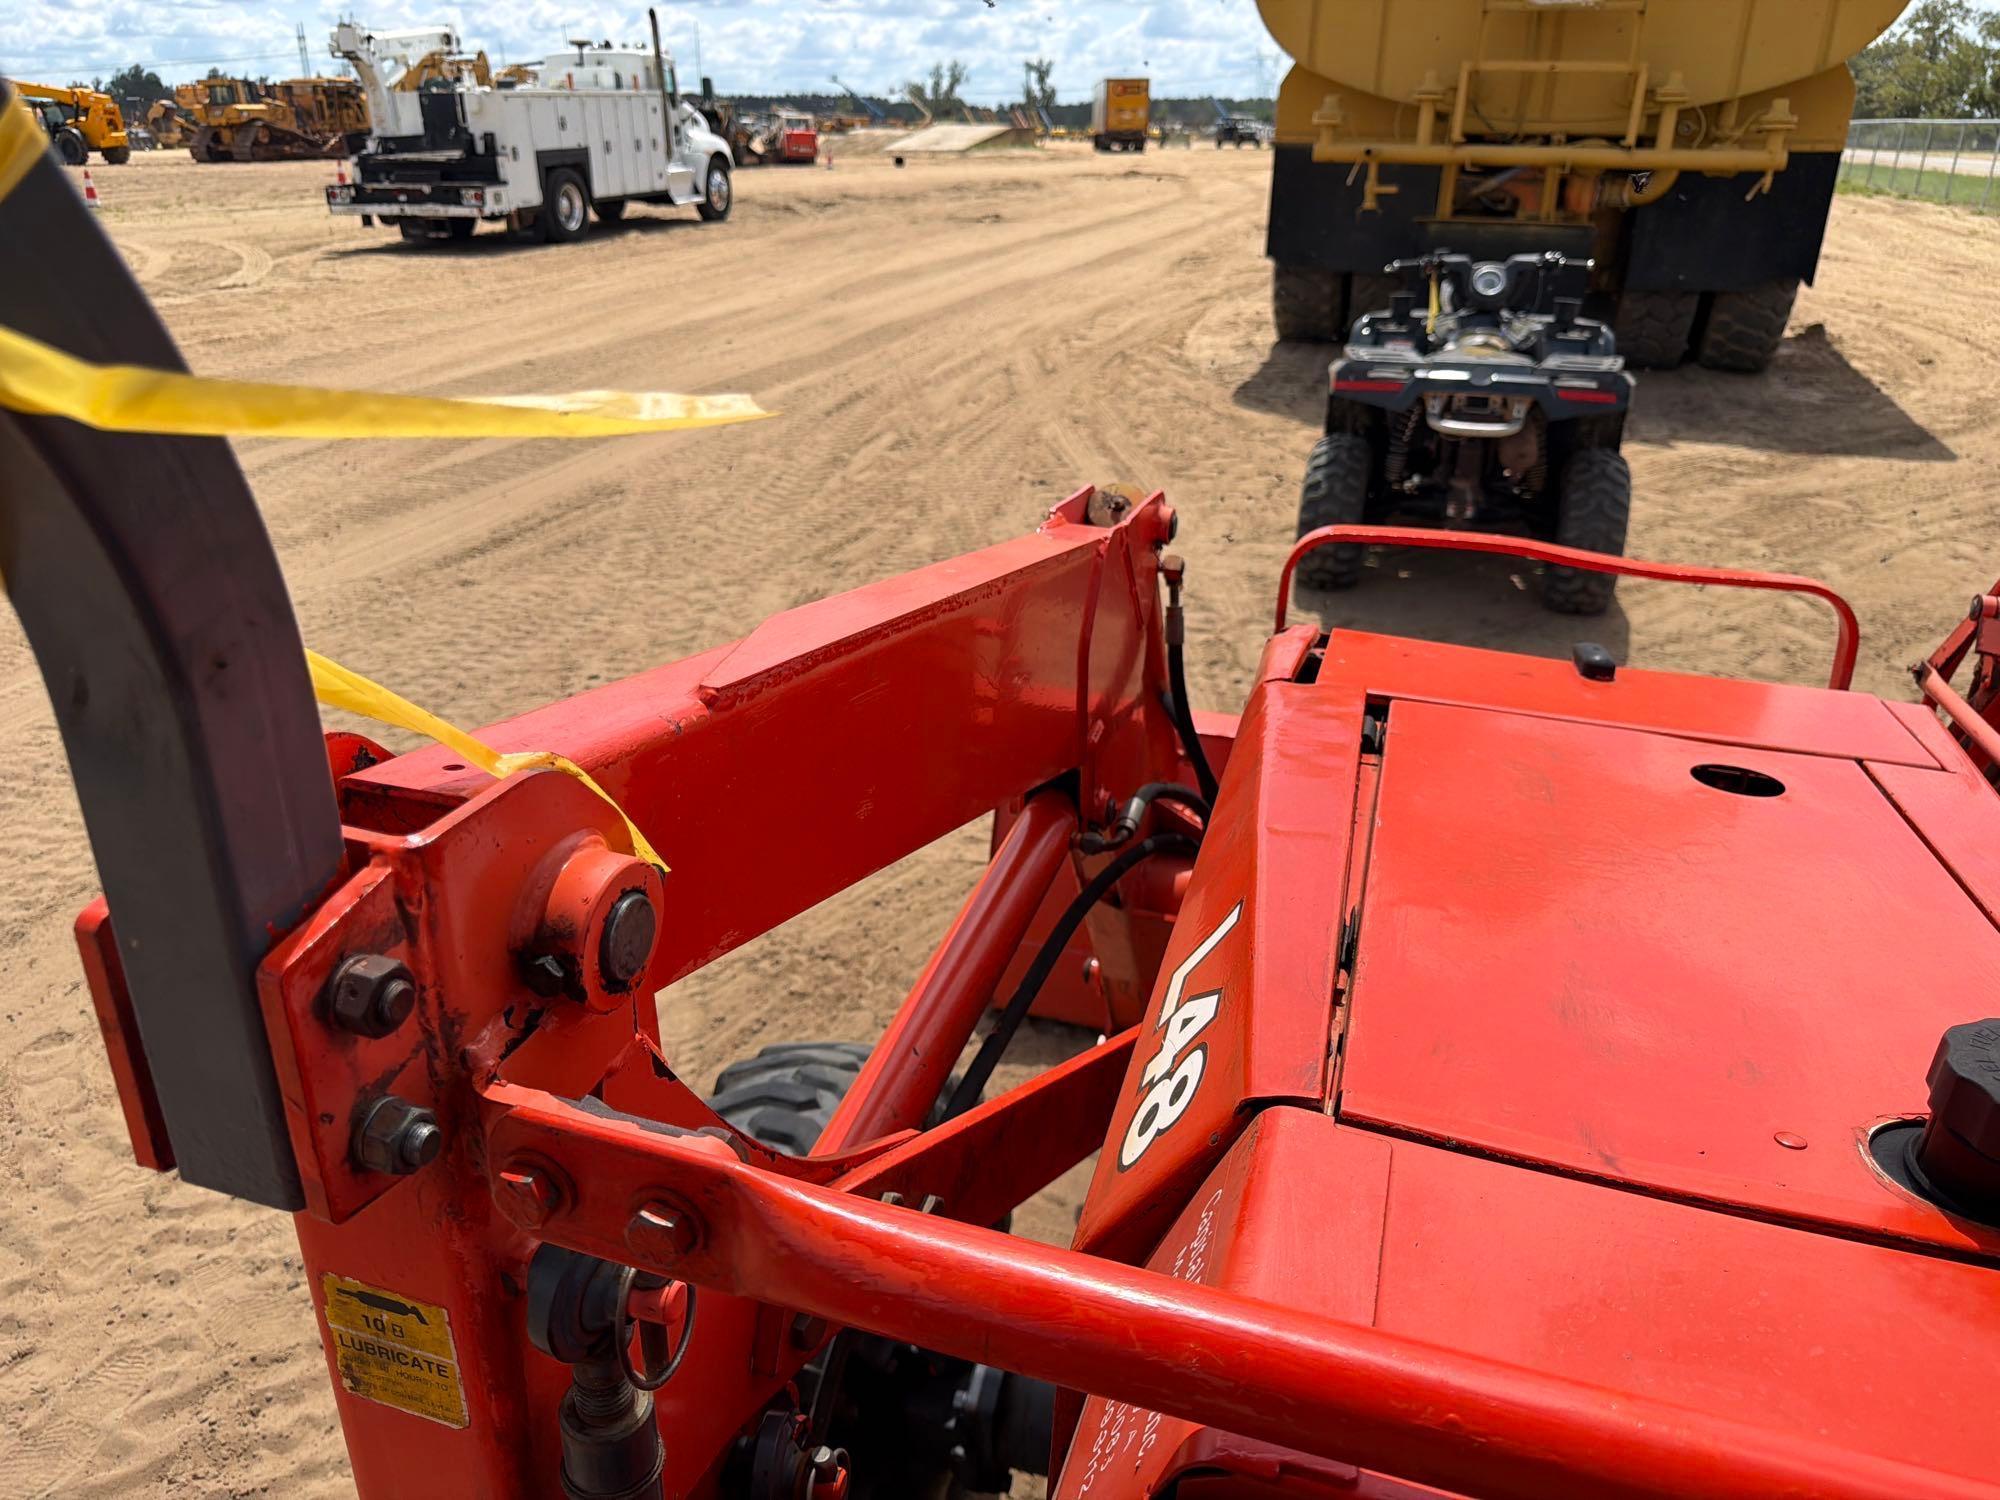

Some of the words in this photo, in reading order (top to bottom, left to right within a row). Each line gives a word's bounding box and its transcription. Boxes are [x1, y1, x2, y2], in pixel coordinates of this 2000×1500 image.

[1117, 896, 1244, 1173] L48
[362, 1314, 386, 1334] 10
[338, 1333, 450, 1379] LUBRICATE
